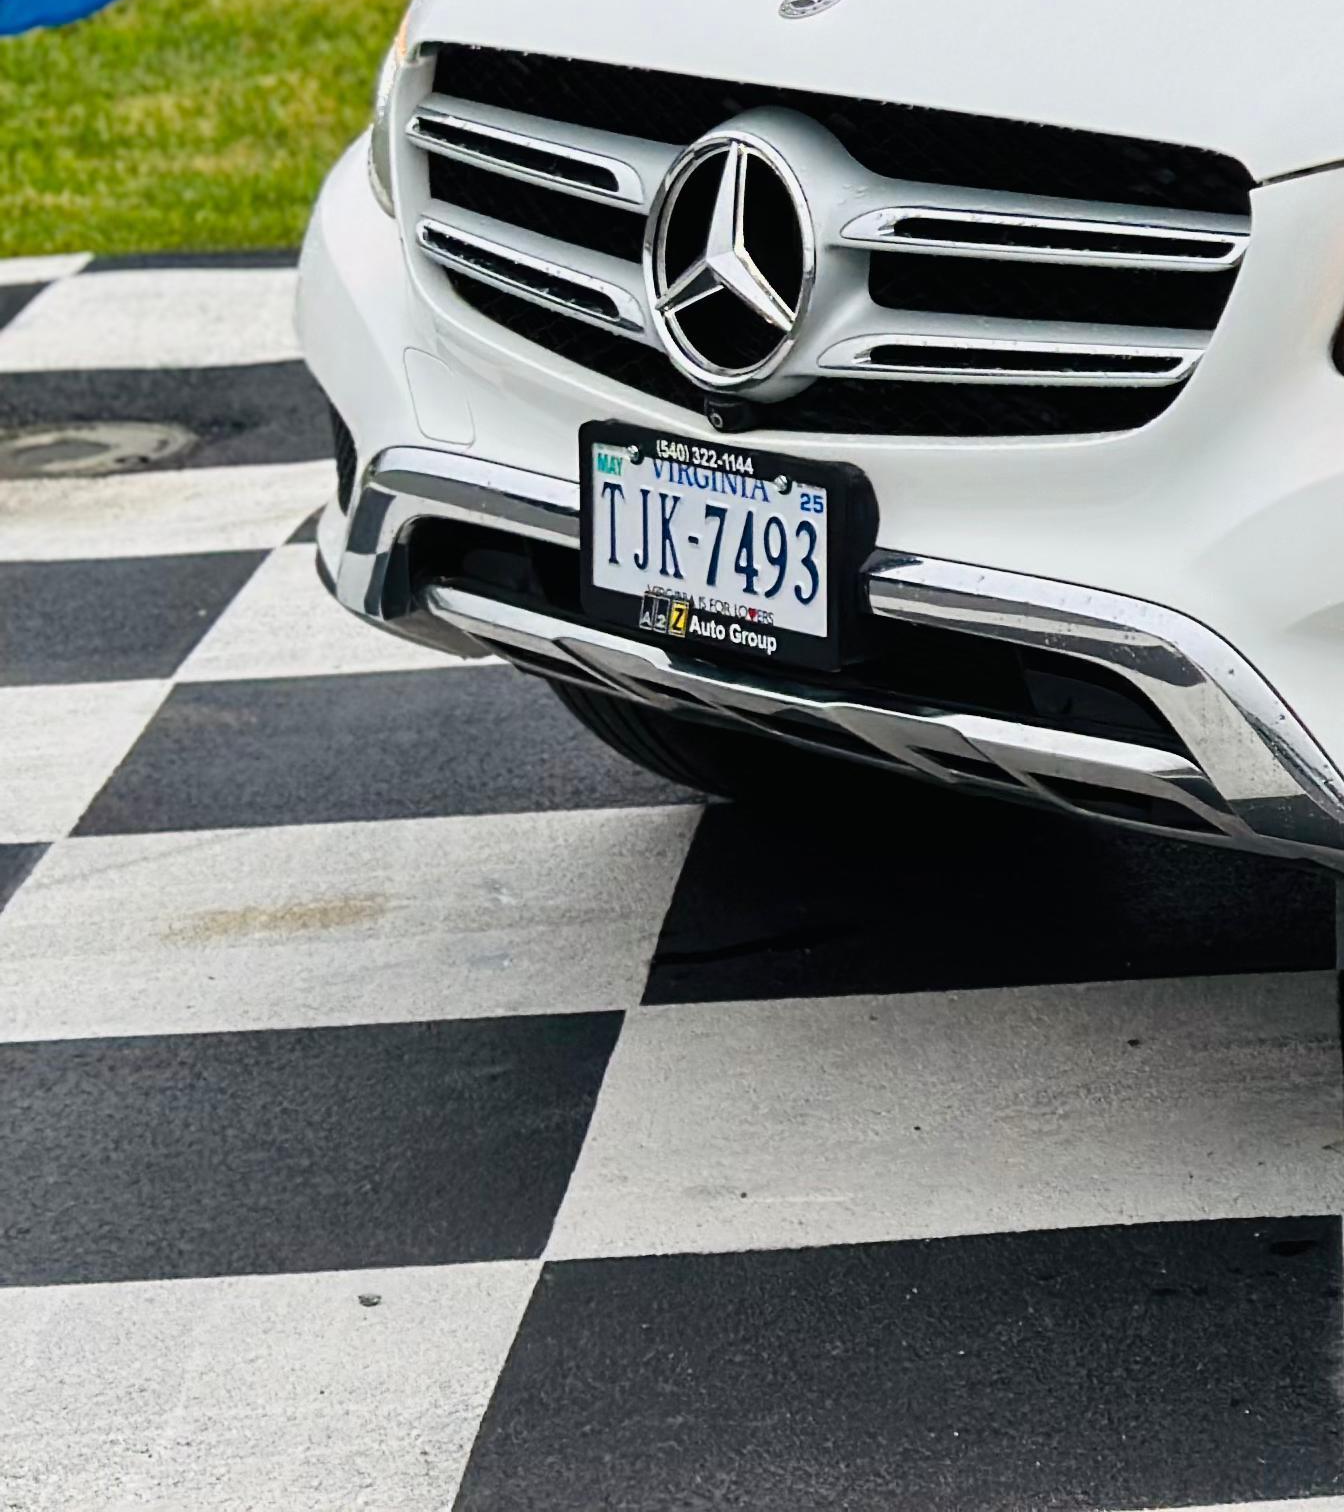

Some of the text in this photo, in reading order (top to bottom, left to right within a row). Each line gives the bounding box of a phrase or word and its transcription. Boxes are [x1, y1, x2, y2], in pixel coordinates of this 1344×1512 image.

[597, 452, 624, 477] MAY
[656, 438, 754, 475] (540) 322-1144
[652, 458, 771, 503] VIRGINIA
[800, 492, 824, 514] 25
[601, 481, 820, 605] TJK-7493
[688, 615, 726, 641] Auto
[729, 623, 777, 655] Group
